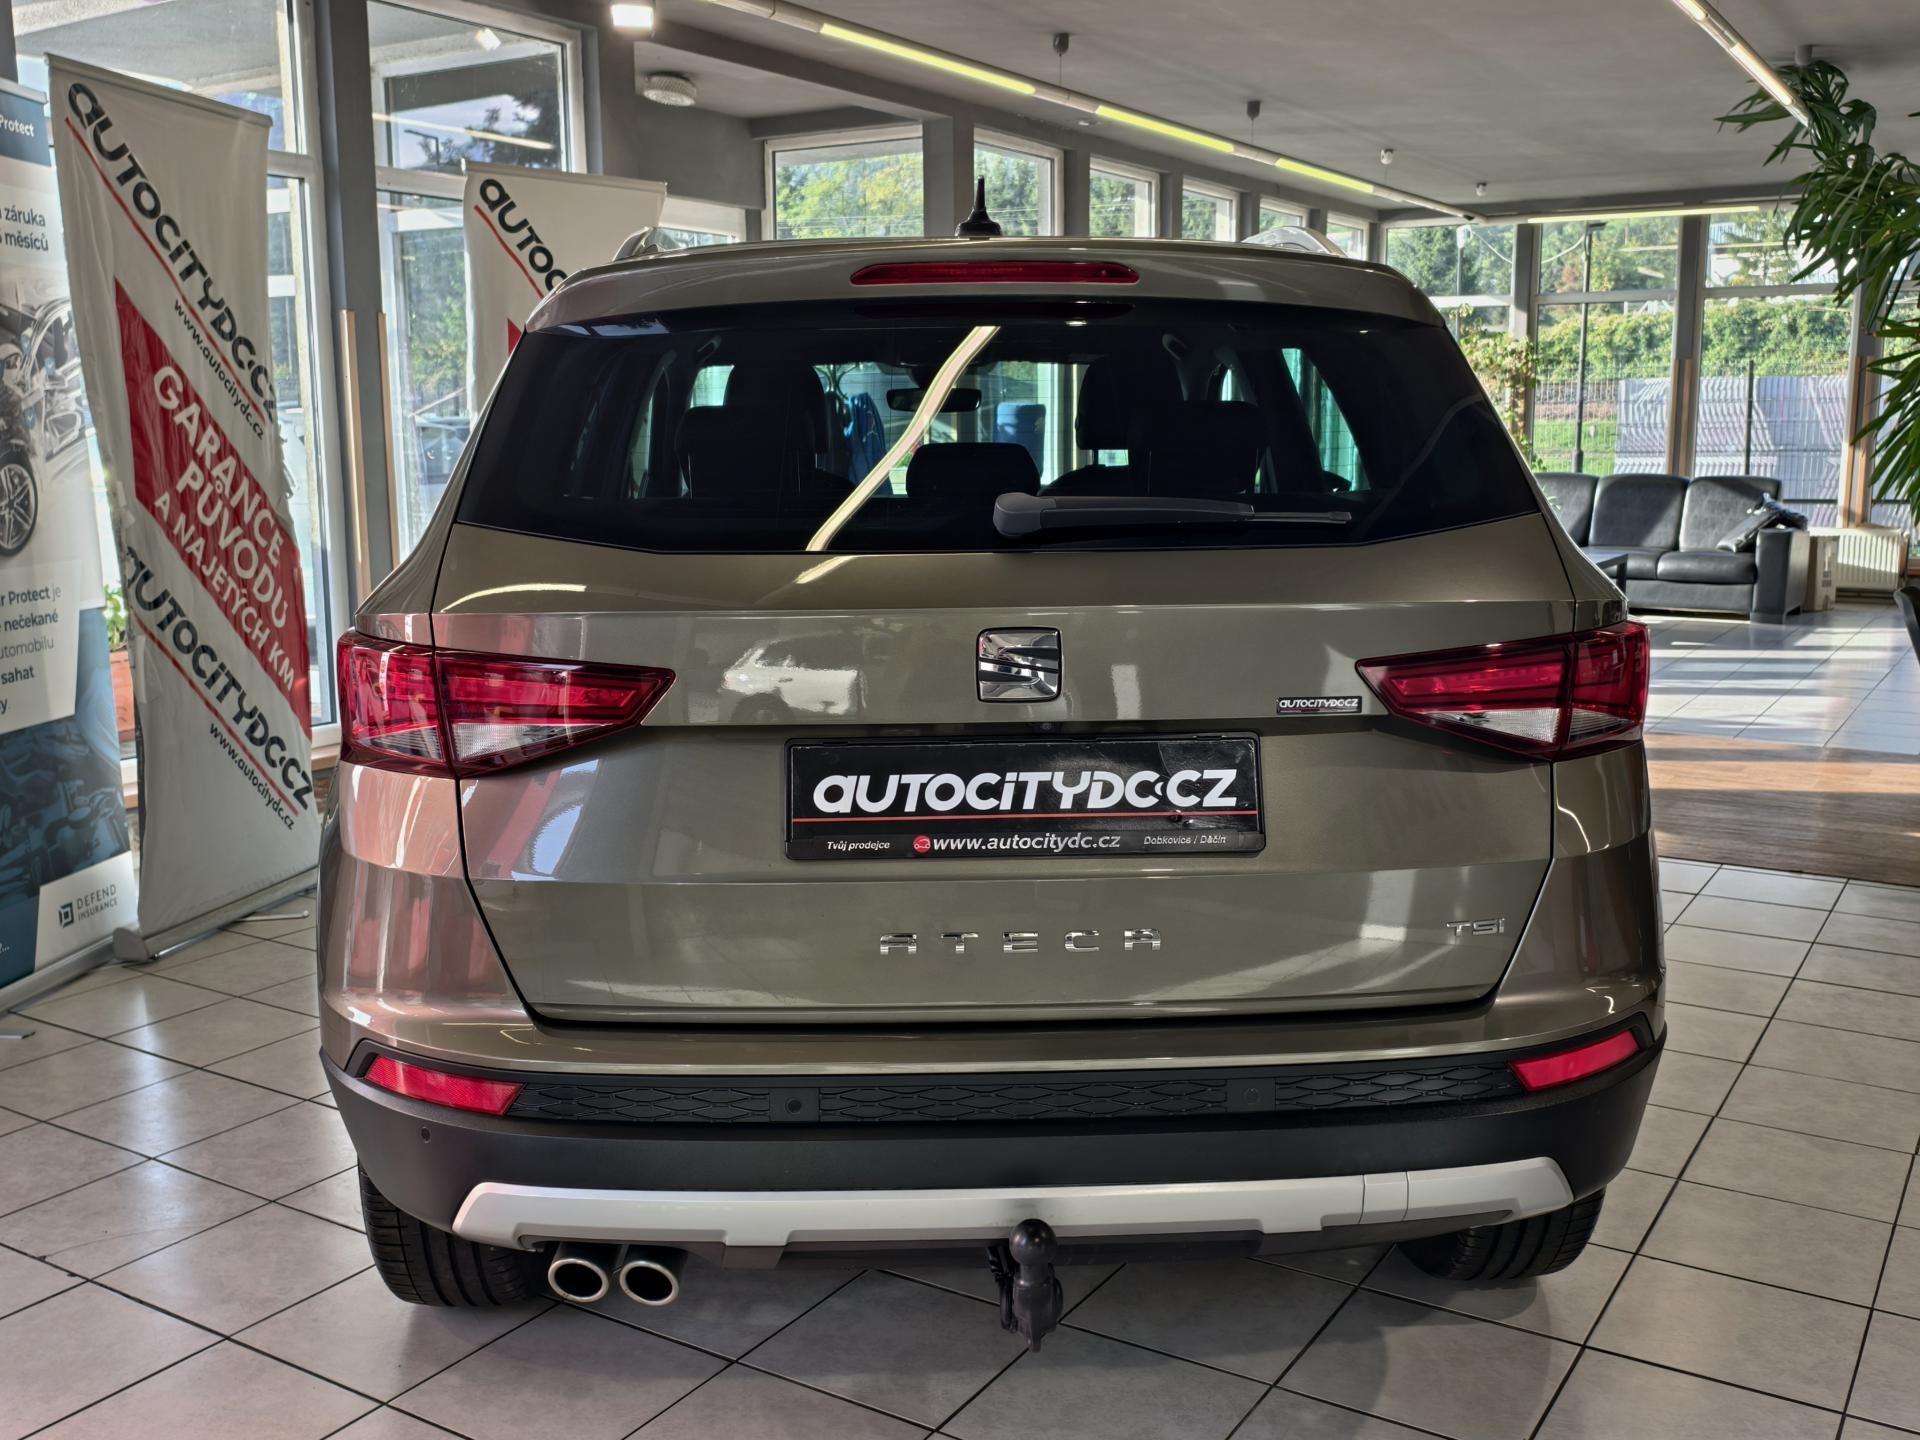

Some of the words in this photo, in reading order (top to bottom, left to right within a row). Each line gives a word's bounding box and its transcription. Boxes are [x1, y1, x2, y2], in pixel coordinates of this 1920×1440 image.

[4, 204, 46, 227] záruka
[5, 231, 49, 251] měsíců
[174, 299, 264, 440] www.autocitydc.cz
[154, 366, 284, 567] GARANCE
[176, 461, 288, 628] PŮVODU
[8, 587, 51, 605] Protect
[154, 491, 170, 521] A
[173, 514, 271, 648] NAJETÝCH
[268, 641, 295, 691] KM
[4, 608, 59, 632] nečekané
[1, 665, 35, 684] sahat
[210, 723, 295, 830] www.autocitydc.cz
[827, 840, 847, 851] Tvůj
[848, 840, 890, 851] prodejce
[933, 833, 1120, 854] www.autocitydc.cz
[1143, 835, 1191, 845] Dobkovice
[76, 884, 117, 910] DEFEND
[77, 897, 118, 921] INSURANCE
[879, 927, 1162, 956] ATECA
